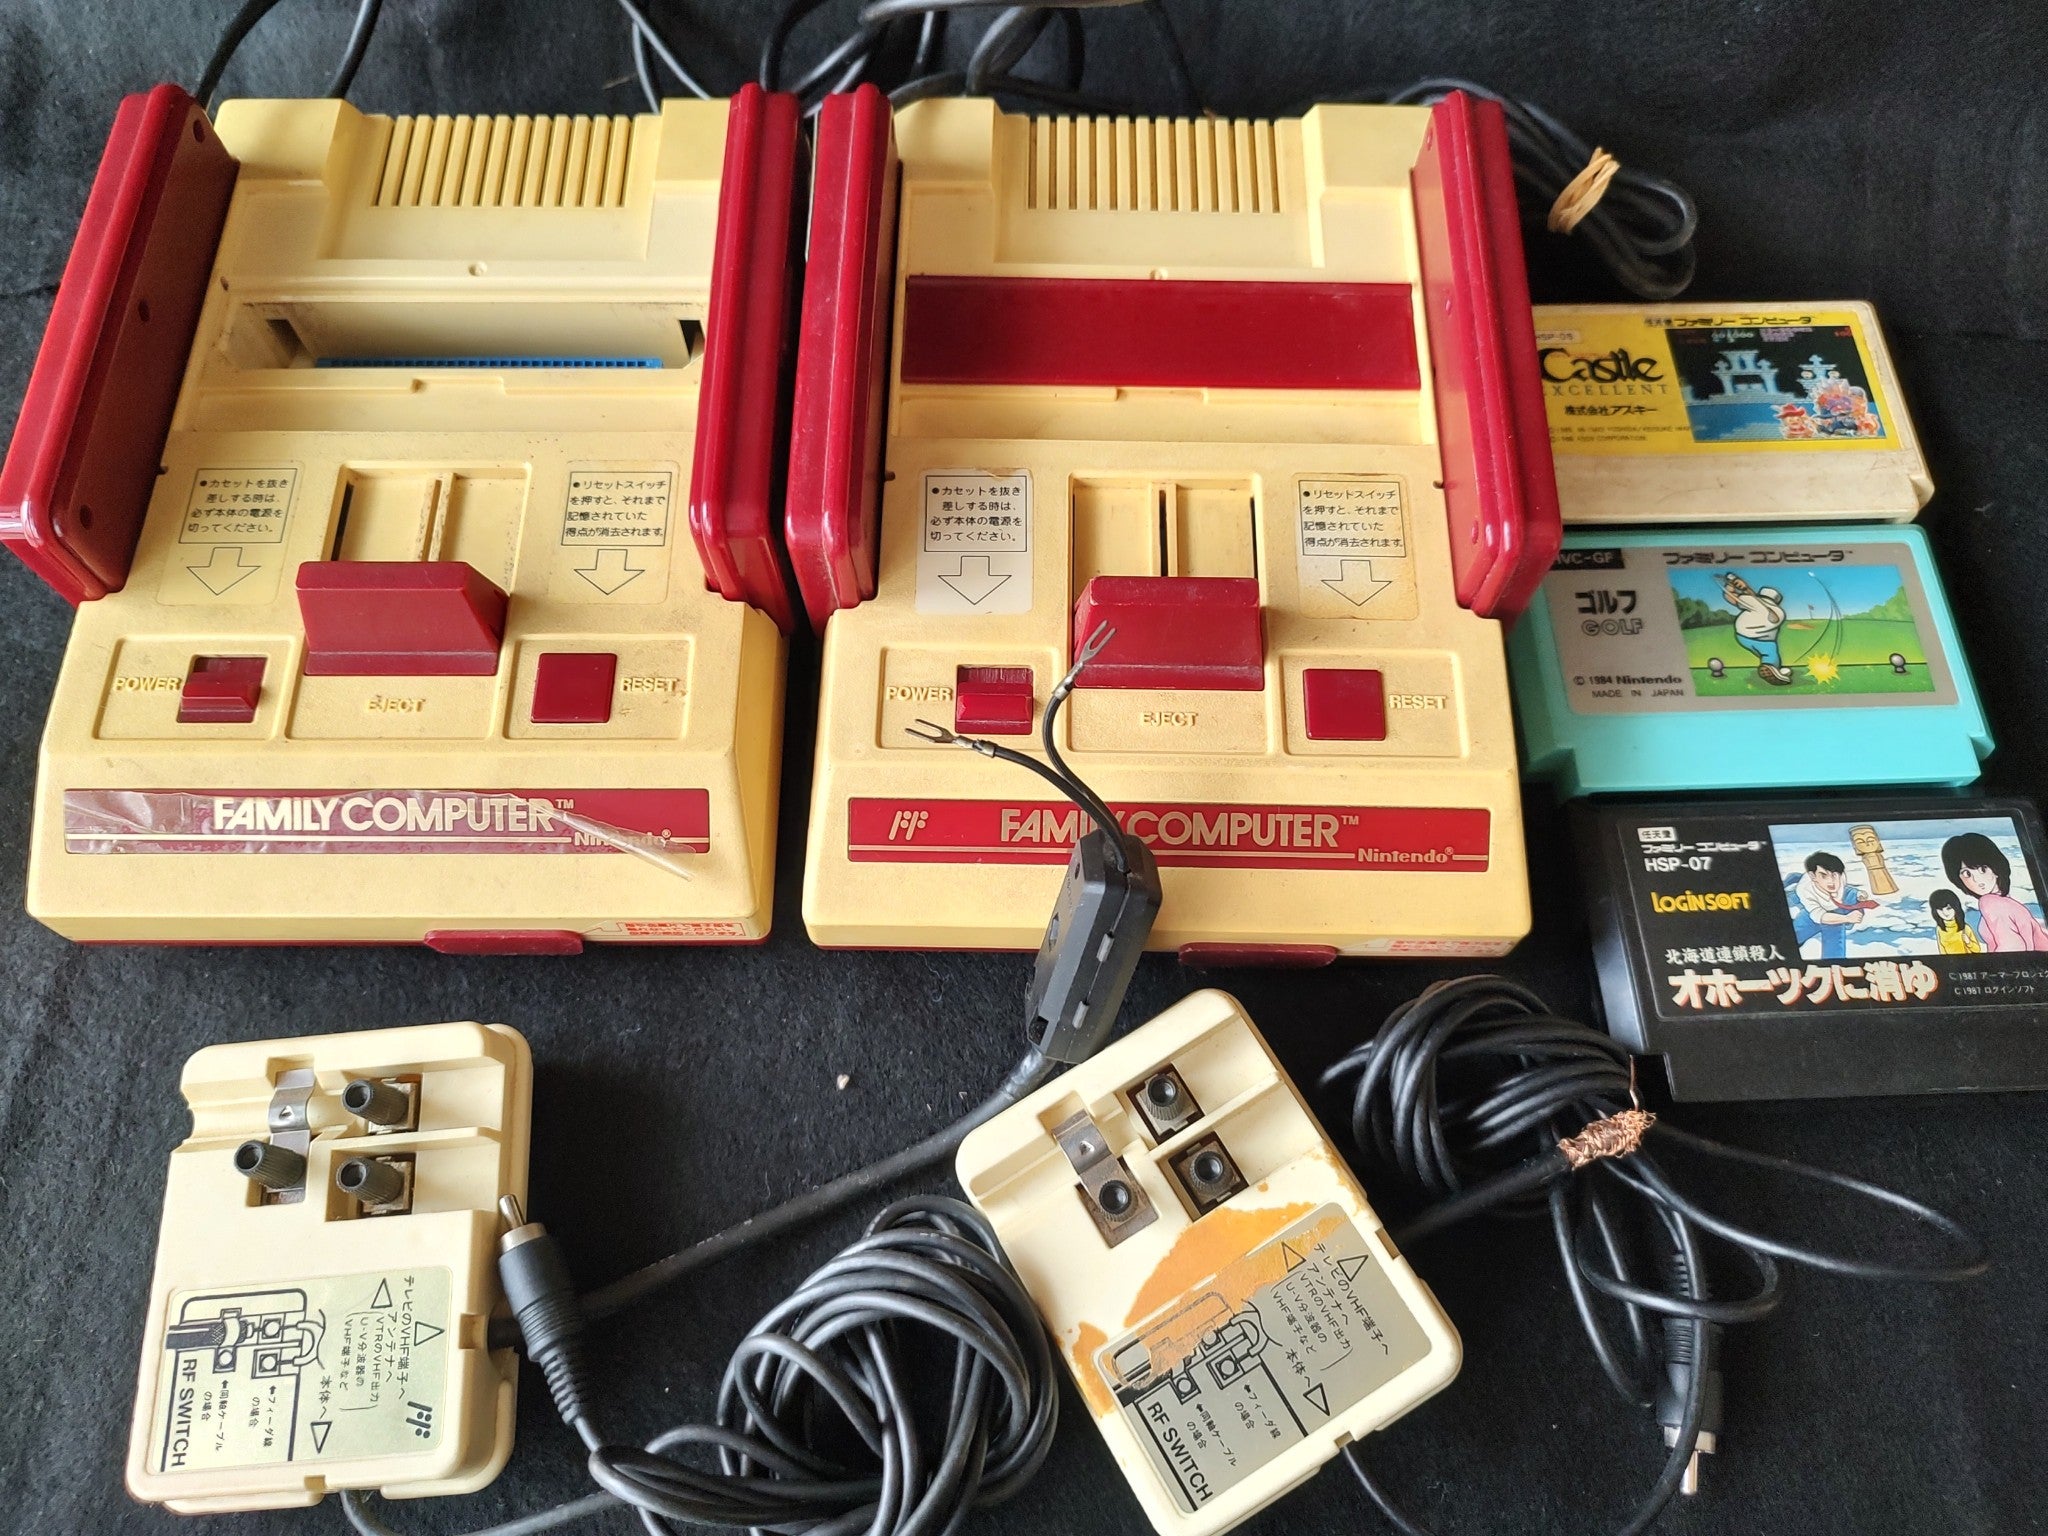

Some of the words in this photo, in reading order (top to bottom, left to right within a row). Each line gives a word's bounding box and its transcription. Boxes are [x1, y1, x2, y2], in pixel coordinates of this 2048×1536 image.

[1537, 347, 1664, 384] Castle
[1543, 383, 1668, 396] XCELLENT
[191, 508, 284, 518] 必ず本体の電源を
[567, 511, 648, 521] 記憶されていた
[930, 516, 1022, 526] 必ず本体の電源を
[187, 523, 273, 533] 切ってください。
[566, 527, 663, 537] 得点が消去されます。
[930, 531, 1016, 541] 切ってください。
[1303, 521, 1384, 531] 記憶されていた
[1305, 537, 1403, 547] 得点が消去されます。
[1575, 590, 1637, 614] ゴルフ
[1581, 618, 1643, 636] GOLF
[112, 677, 182, 691] POWER
[621, 677, 678, 692] RESET
[1589, 676, 1612, 685] 1984
[1616, 675, 1682, 684] Nintendo
[885, 686, 954, 701] POWER
[1388, 695, 1447, 709] RESET
[1592, 689, 1621, 698] MADE
[1651, 688, 1684, 697] JAPAN
[368, 698, 426, 713] EJECT
[1141, 711, 1198, 727] EJECT
[213, 797, 340, 832] FAMILY
[1644, 856, 1712, 872] HSP-07
[1665, 944, 1785, 965] 北海道連鎖殺人
[1668, 960, 1939, 1010] オホーツクに消ゆ
[1984, 985, 2035, 994] ログインソフト
[1307, 1262, 1348, 1326] アンテナへ
[1314, 1243, 1389, 1356] テレビのVHF端子へ
[1300, 1273, 1351, 1350] VTRのVHF出力
[1272, 1291, 1317, 1355] VHF端子など
[339, 1319, 354, 1391] VHF端子など
[385, 1311, 397, 1382] アンテナへ
[370, 1316, 385, 1402] VTRのVHF出力
[1285, 1348, 1311, 1388] 本体へ
[182, 1358, 198, 1383] RF
[201, 1391, 213, 1421] の場合
[319, 1375, 333, 1419] 本体へ
[249, 1397, 261, 1427] の場合
[1234, 1401, 1256, 1430] の場合
[171, 1387, 195, 1467] SWITCH
[1186, 1421, 1208, 1449] の場合
[1200, 1410, 1237, 1467] 同軸ケーブル
[1147, 1401, 1171, 1425] RF
[1162, 1427, 1214, 1502] SWITCH
